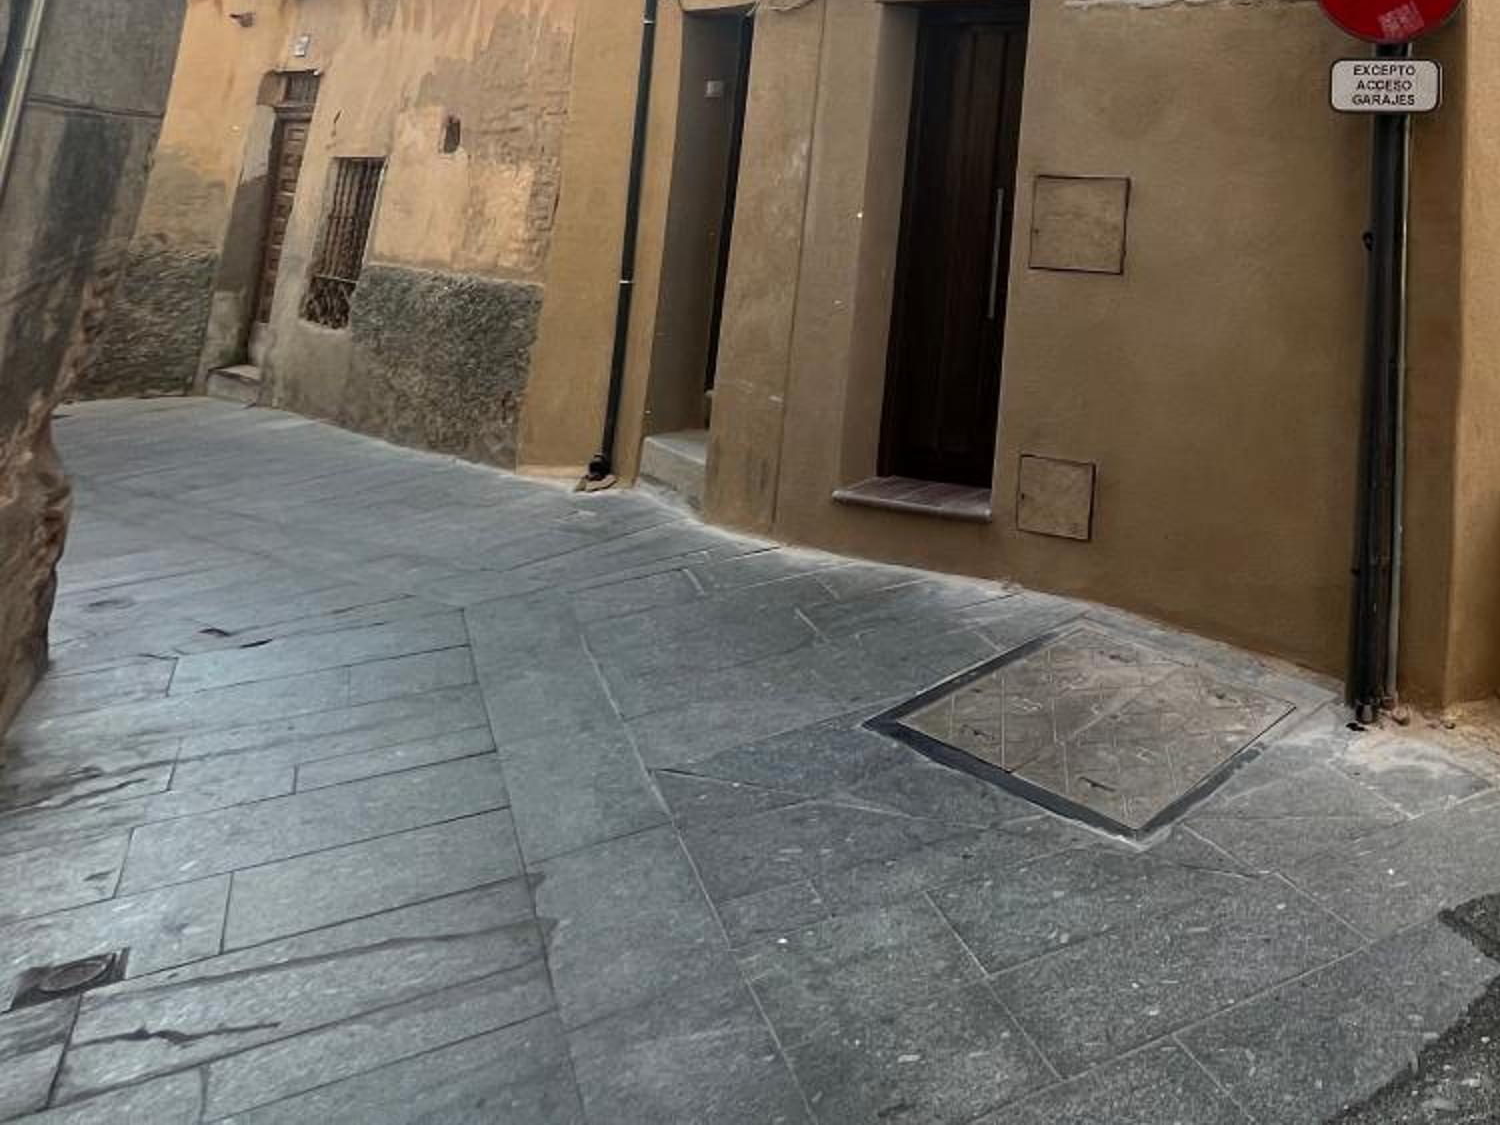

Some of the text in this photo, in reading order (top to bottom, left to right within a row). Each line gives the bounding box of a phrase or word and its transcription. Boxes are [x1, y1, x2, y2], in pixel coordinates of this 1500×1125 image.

[1353, 64, 1416, 76] EXCEPTO
[1356, 79, 1413, 91] ACCESO
[1352, 94, 1415, 106] GARAJES
